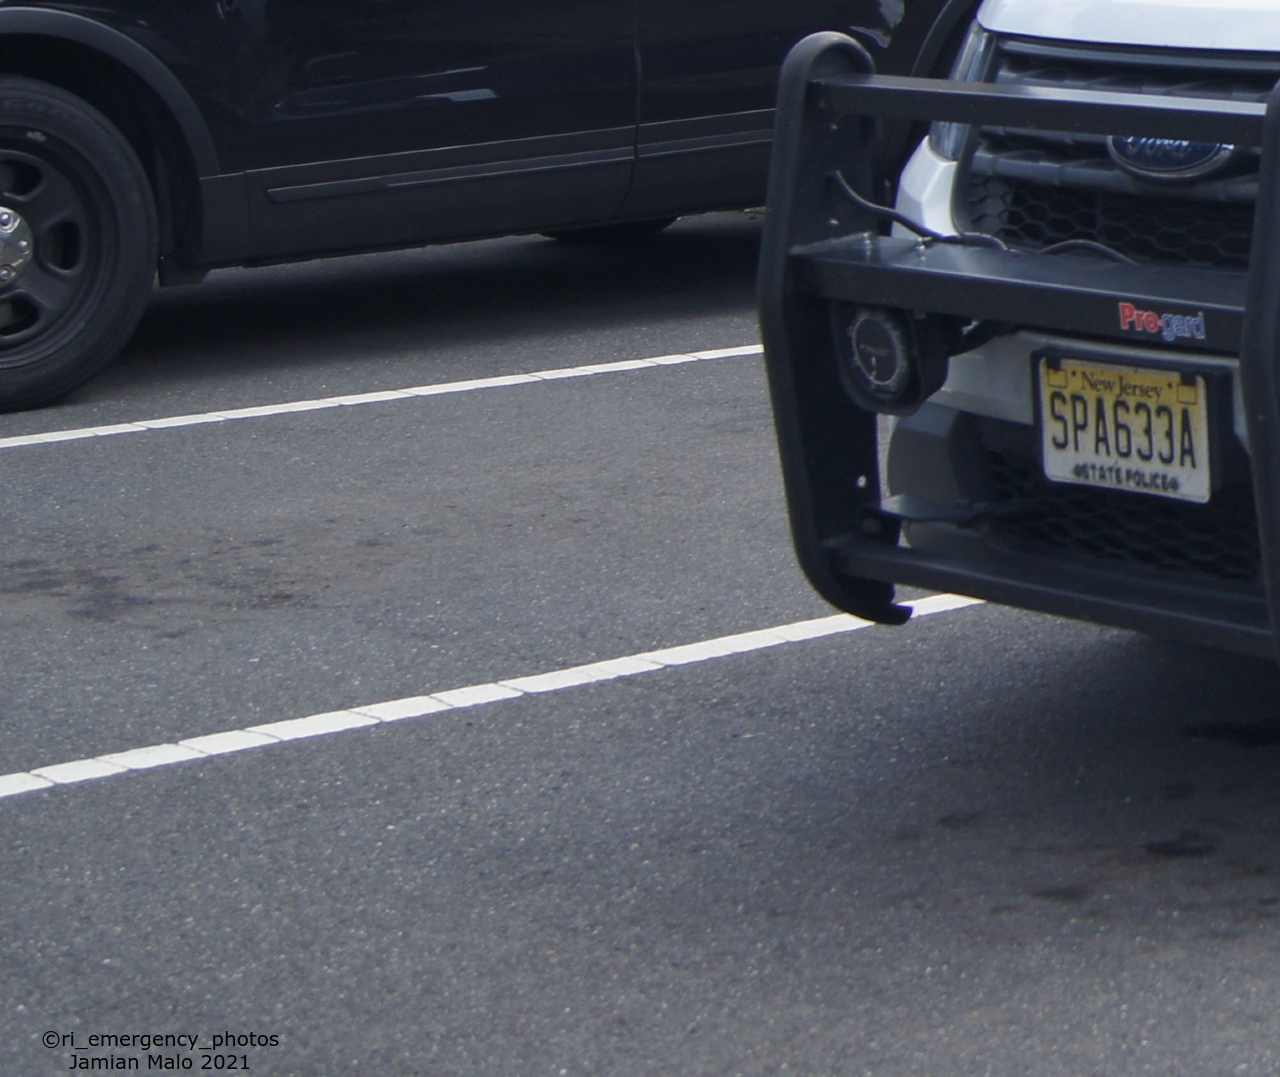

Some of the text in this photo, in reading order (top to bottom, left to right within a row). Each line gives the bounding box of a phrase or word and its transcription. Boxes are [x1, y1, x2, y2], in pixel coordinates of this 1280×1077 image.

[1118, 302, 1206, 341] Pro-gard
[1081, 372, 1162, 402] New Jersey
[1051, 391, 1197, 469] SPA633A
[1083, 464, 1169, 490] STATE POLICE
